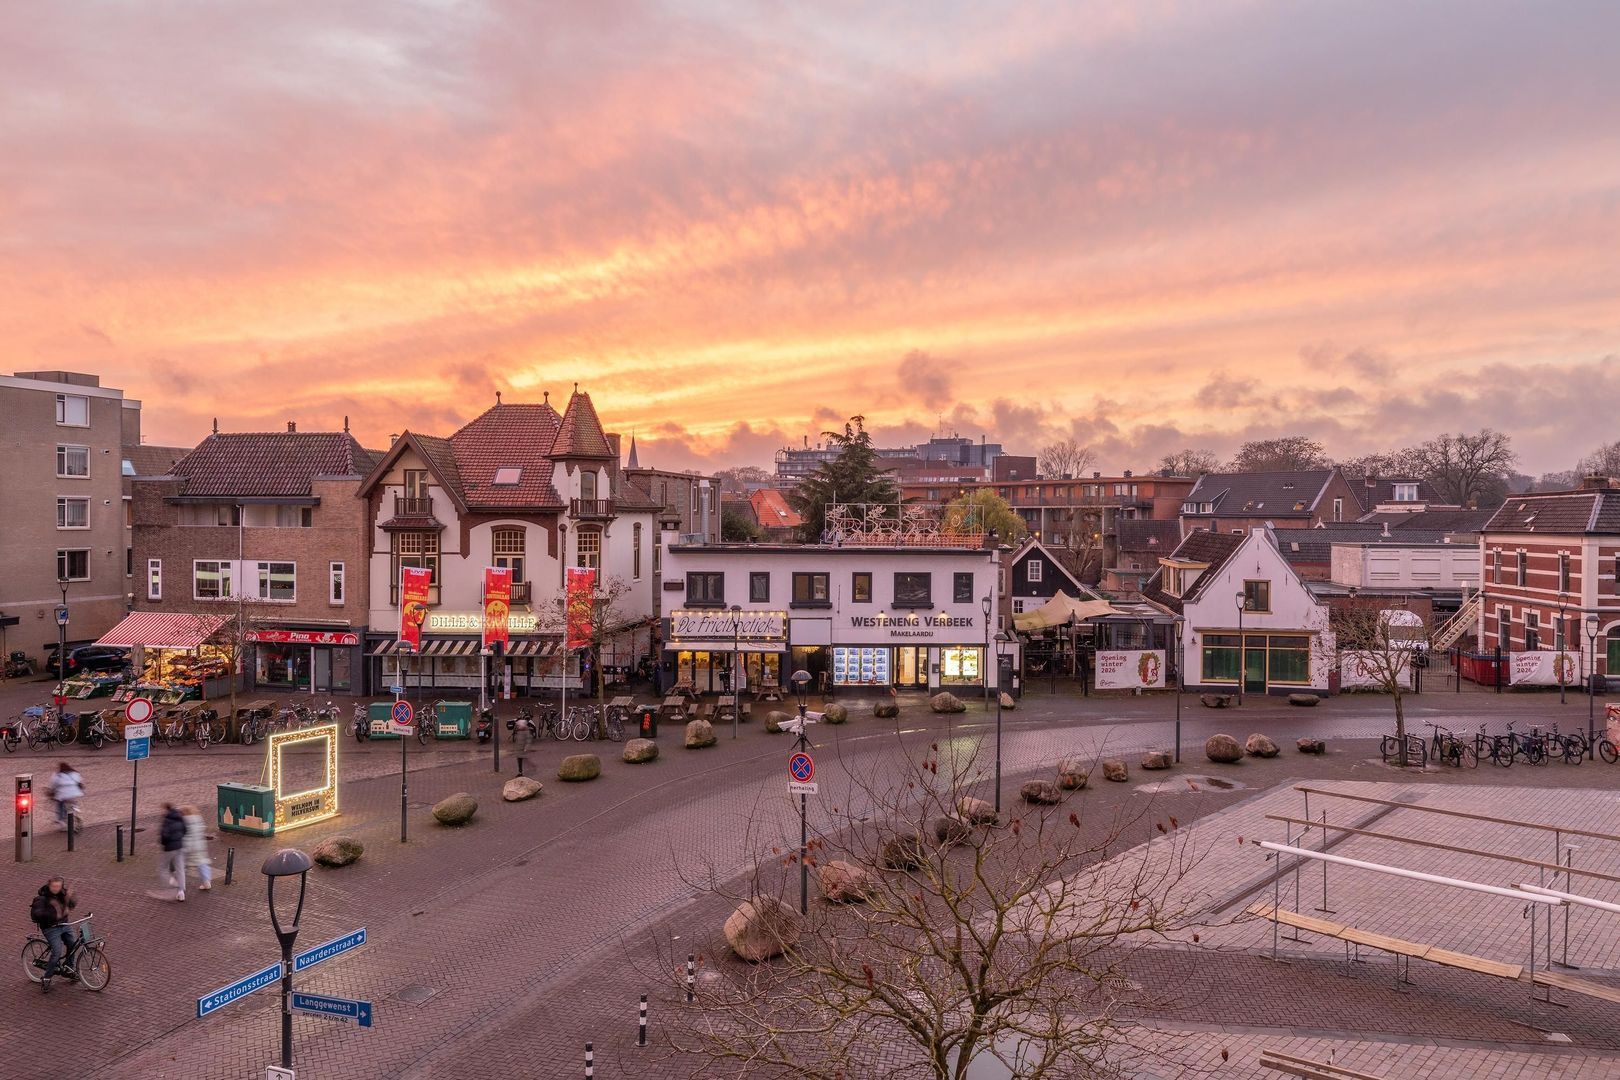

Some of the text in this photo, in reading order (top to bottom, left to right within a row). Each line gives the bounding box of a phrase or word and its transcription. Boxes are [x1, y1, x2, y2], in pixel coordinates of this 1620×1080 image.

[431, 616, 466, 628] DILLE
[469, 617, 477, 628] &
[677, 616, 696, 634] De
[851, 616, 973, 627] WESTENENG VERBEEK
[299, 938, 355, 966] Naarderstraat
[213, 970, 278, 1006] Stationsstraat
[299, 996, 351, 1012] Langgewenst
